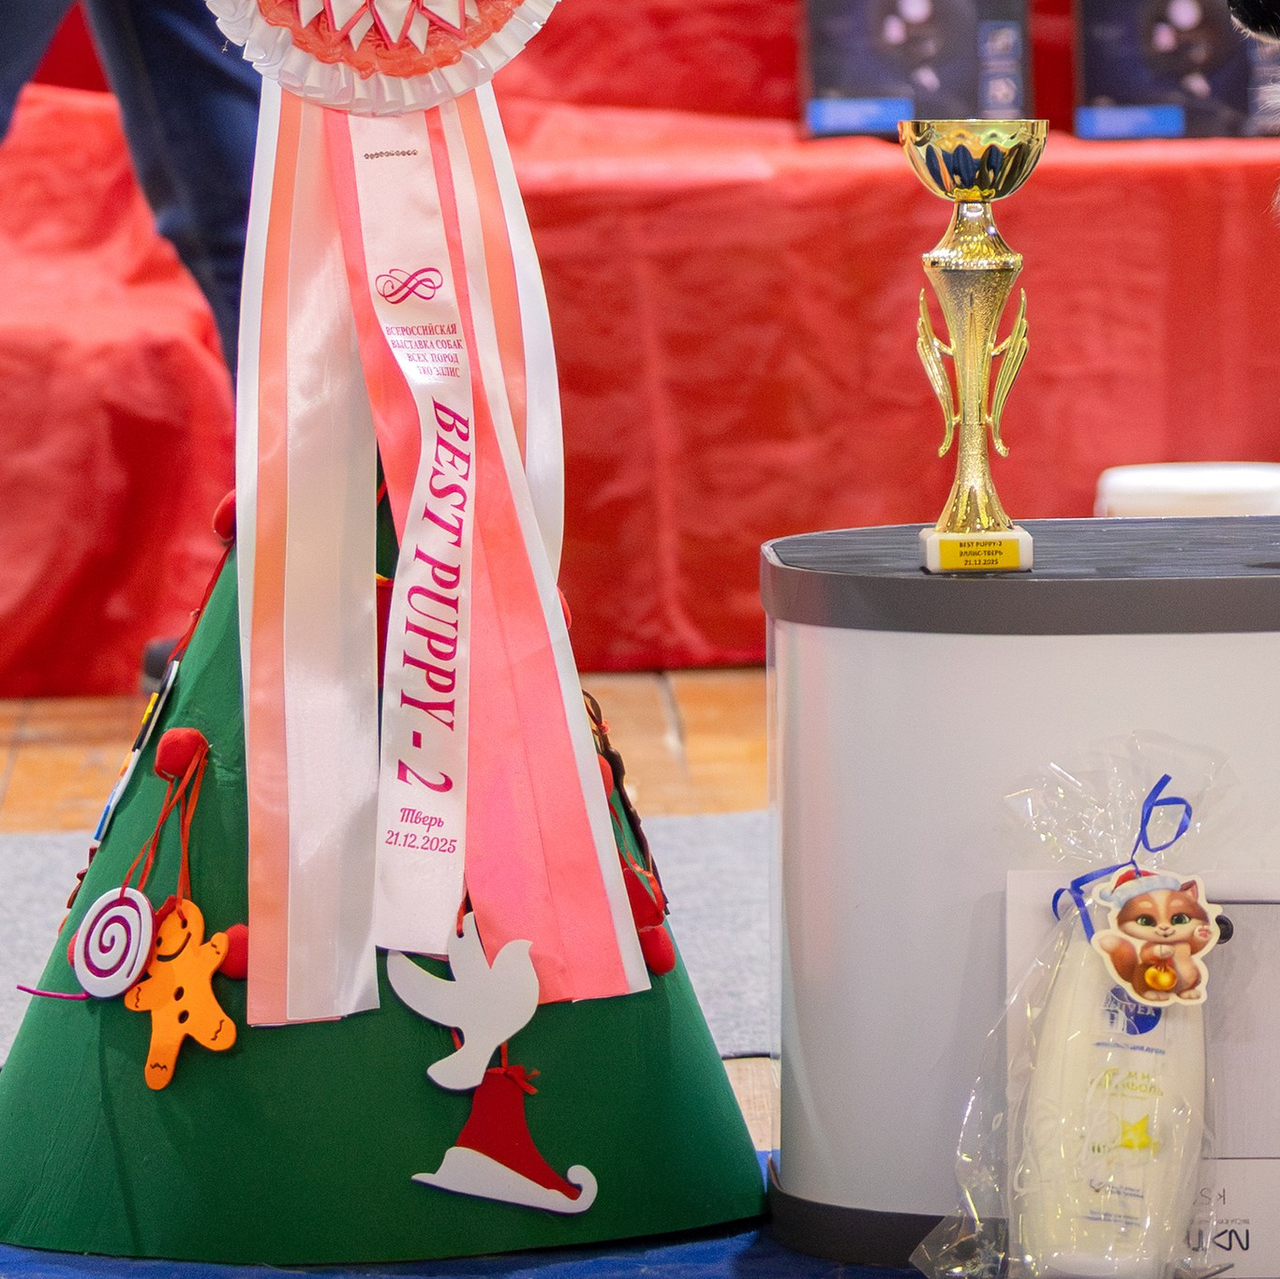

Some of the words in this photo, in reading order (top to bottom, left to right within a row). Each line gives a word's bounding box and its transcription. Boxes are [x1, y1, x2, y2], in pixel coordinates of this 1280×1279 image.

[385, 323, 457, 336] ВСЕРОССИЙСКАЯ
[391, 339, 435, 350] ВЫСТАВКА
[435, 339, 463, 350] СОБАК
[407, 353, 429, 363] ВСЕХ
[430, 353, 459, 365] ПОРОД
[422, 395, 471, 548] BEST
[400, 543, 461, 732] PUPPY
[397, 758, 453, 793] 2
[400, 807, 444, 831] Тверь
[385, 829, 457, 854] 21.12.2025
